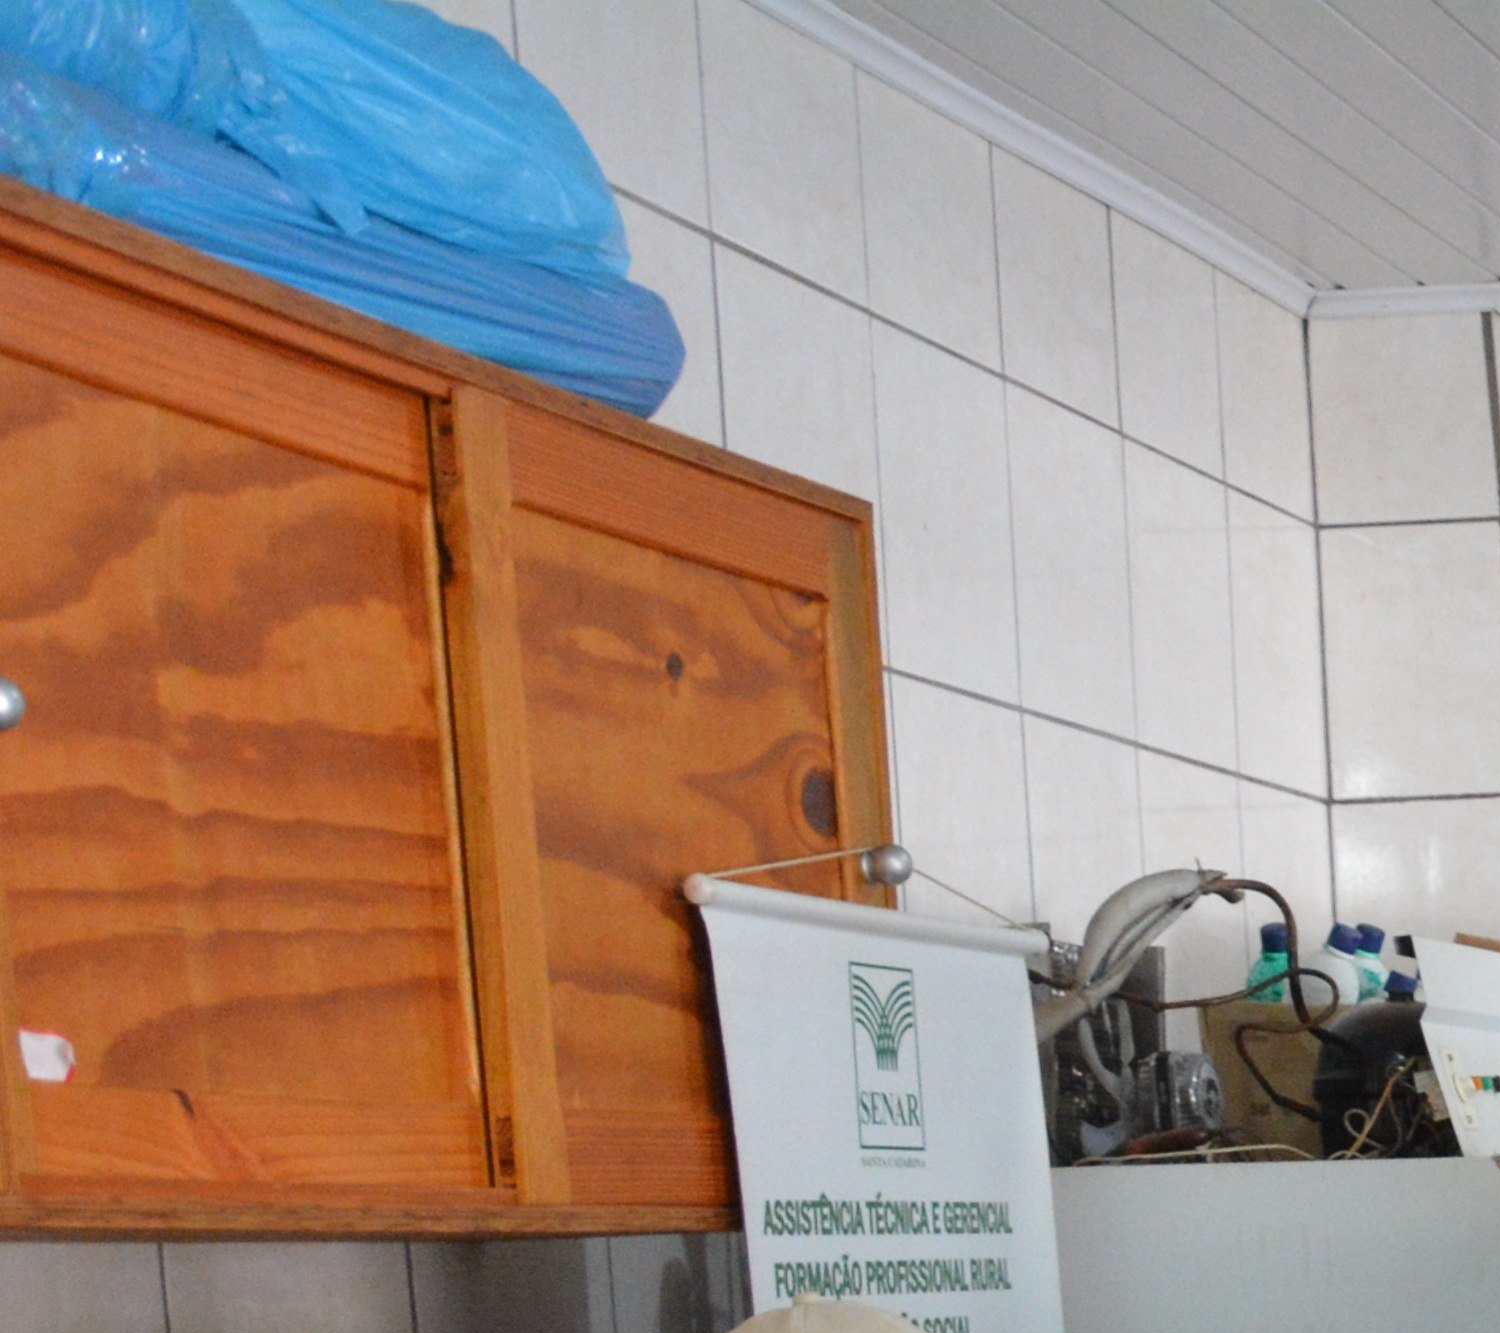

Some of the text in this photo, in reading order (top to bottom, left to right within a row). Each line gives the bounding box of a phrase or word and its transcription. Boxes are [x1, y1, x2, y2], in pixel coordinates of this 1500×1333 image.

[859, 1090, 921, 1127] SENAR
[764, 1190, 1013, 1236] ASSISTÊNCIA TÉCNICA E GERENCIAL
[774, 1253, 1012, 1300] FORMAÇÃO PROFISSIONAL RURAL
